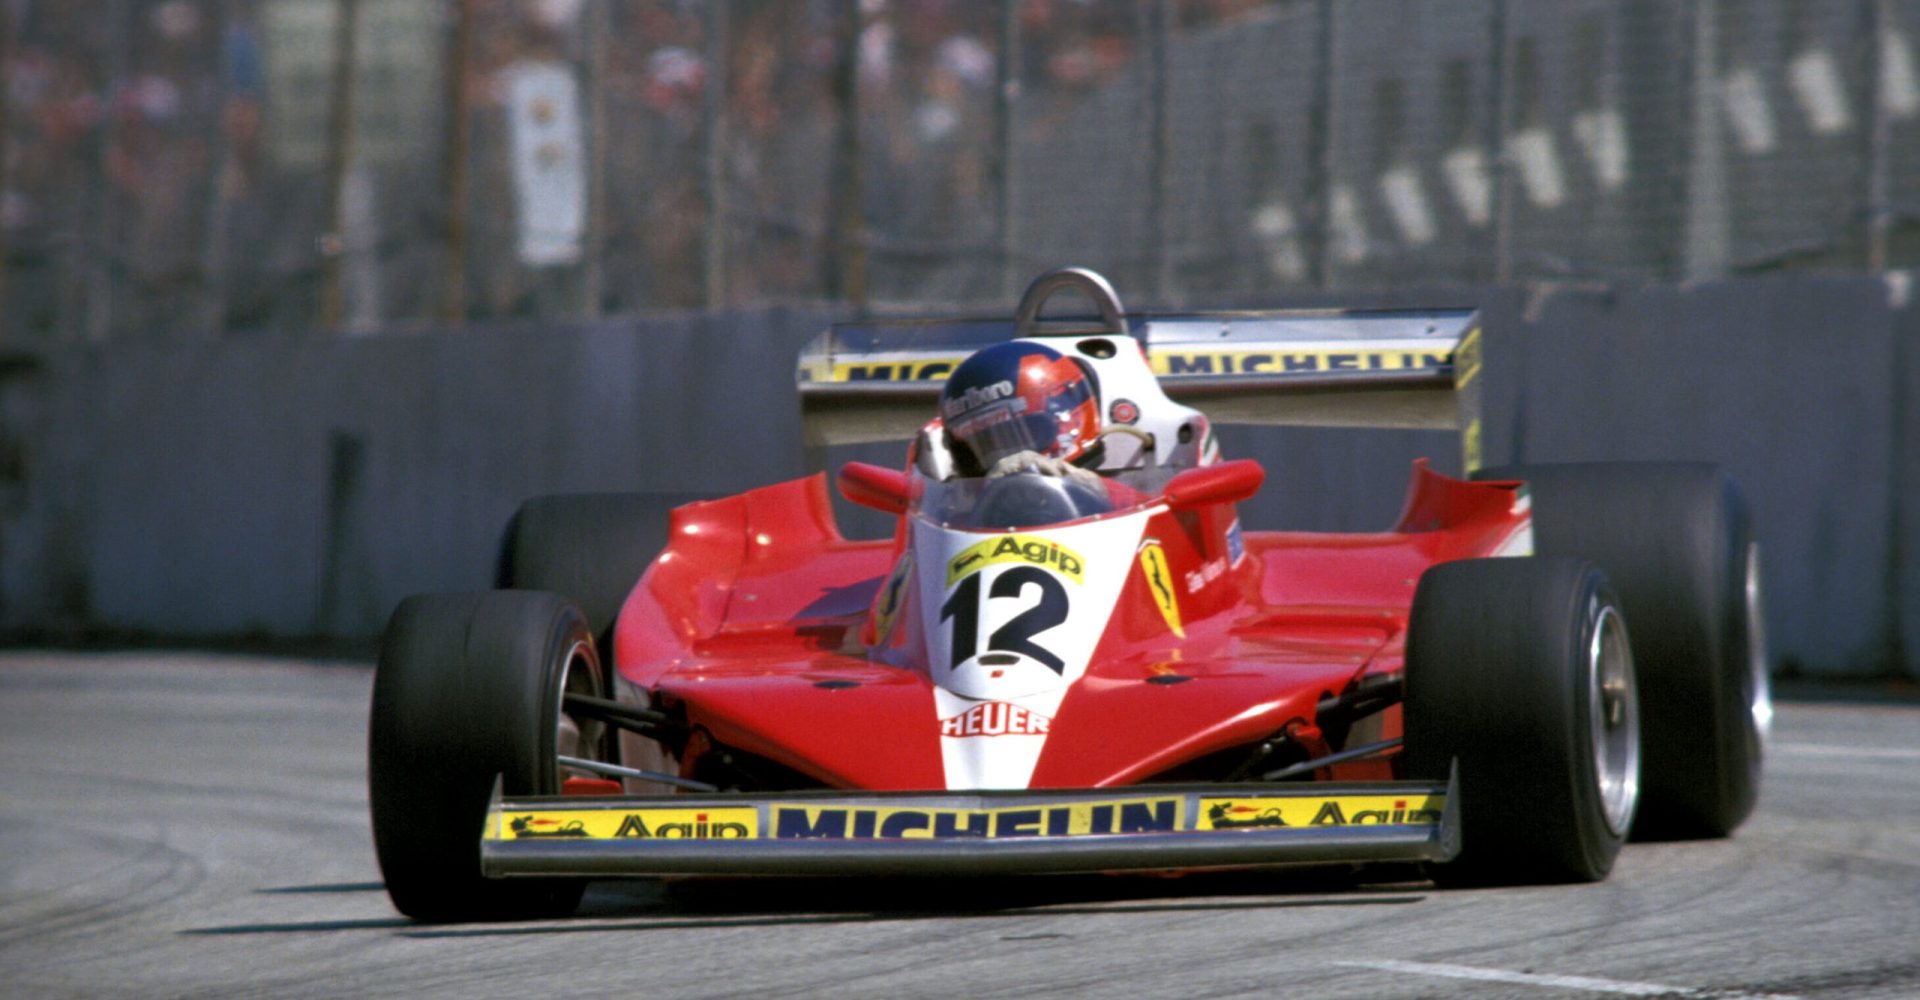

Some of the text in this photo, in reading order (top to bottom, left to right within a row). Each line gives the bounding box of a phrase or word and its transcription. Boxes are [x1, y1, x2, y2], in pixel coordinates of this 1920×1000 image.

[992, 536, 1082, 575] Agip
[940, 565, 1070, 677] 12
[941, 703, 1051, 735] HEUER
[776, 800, 1177, 838] MICHELIN
